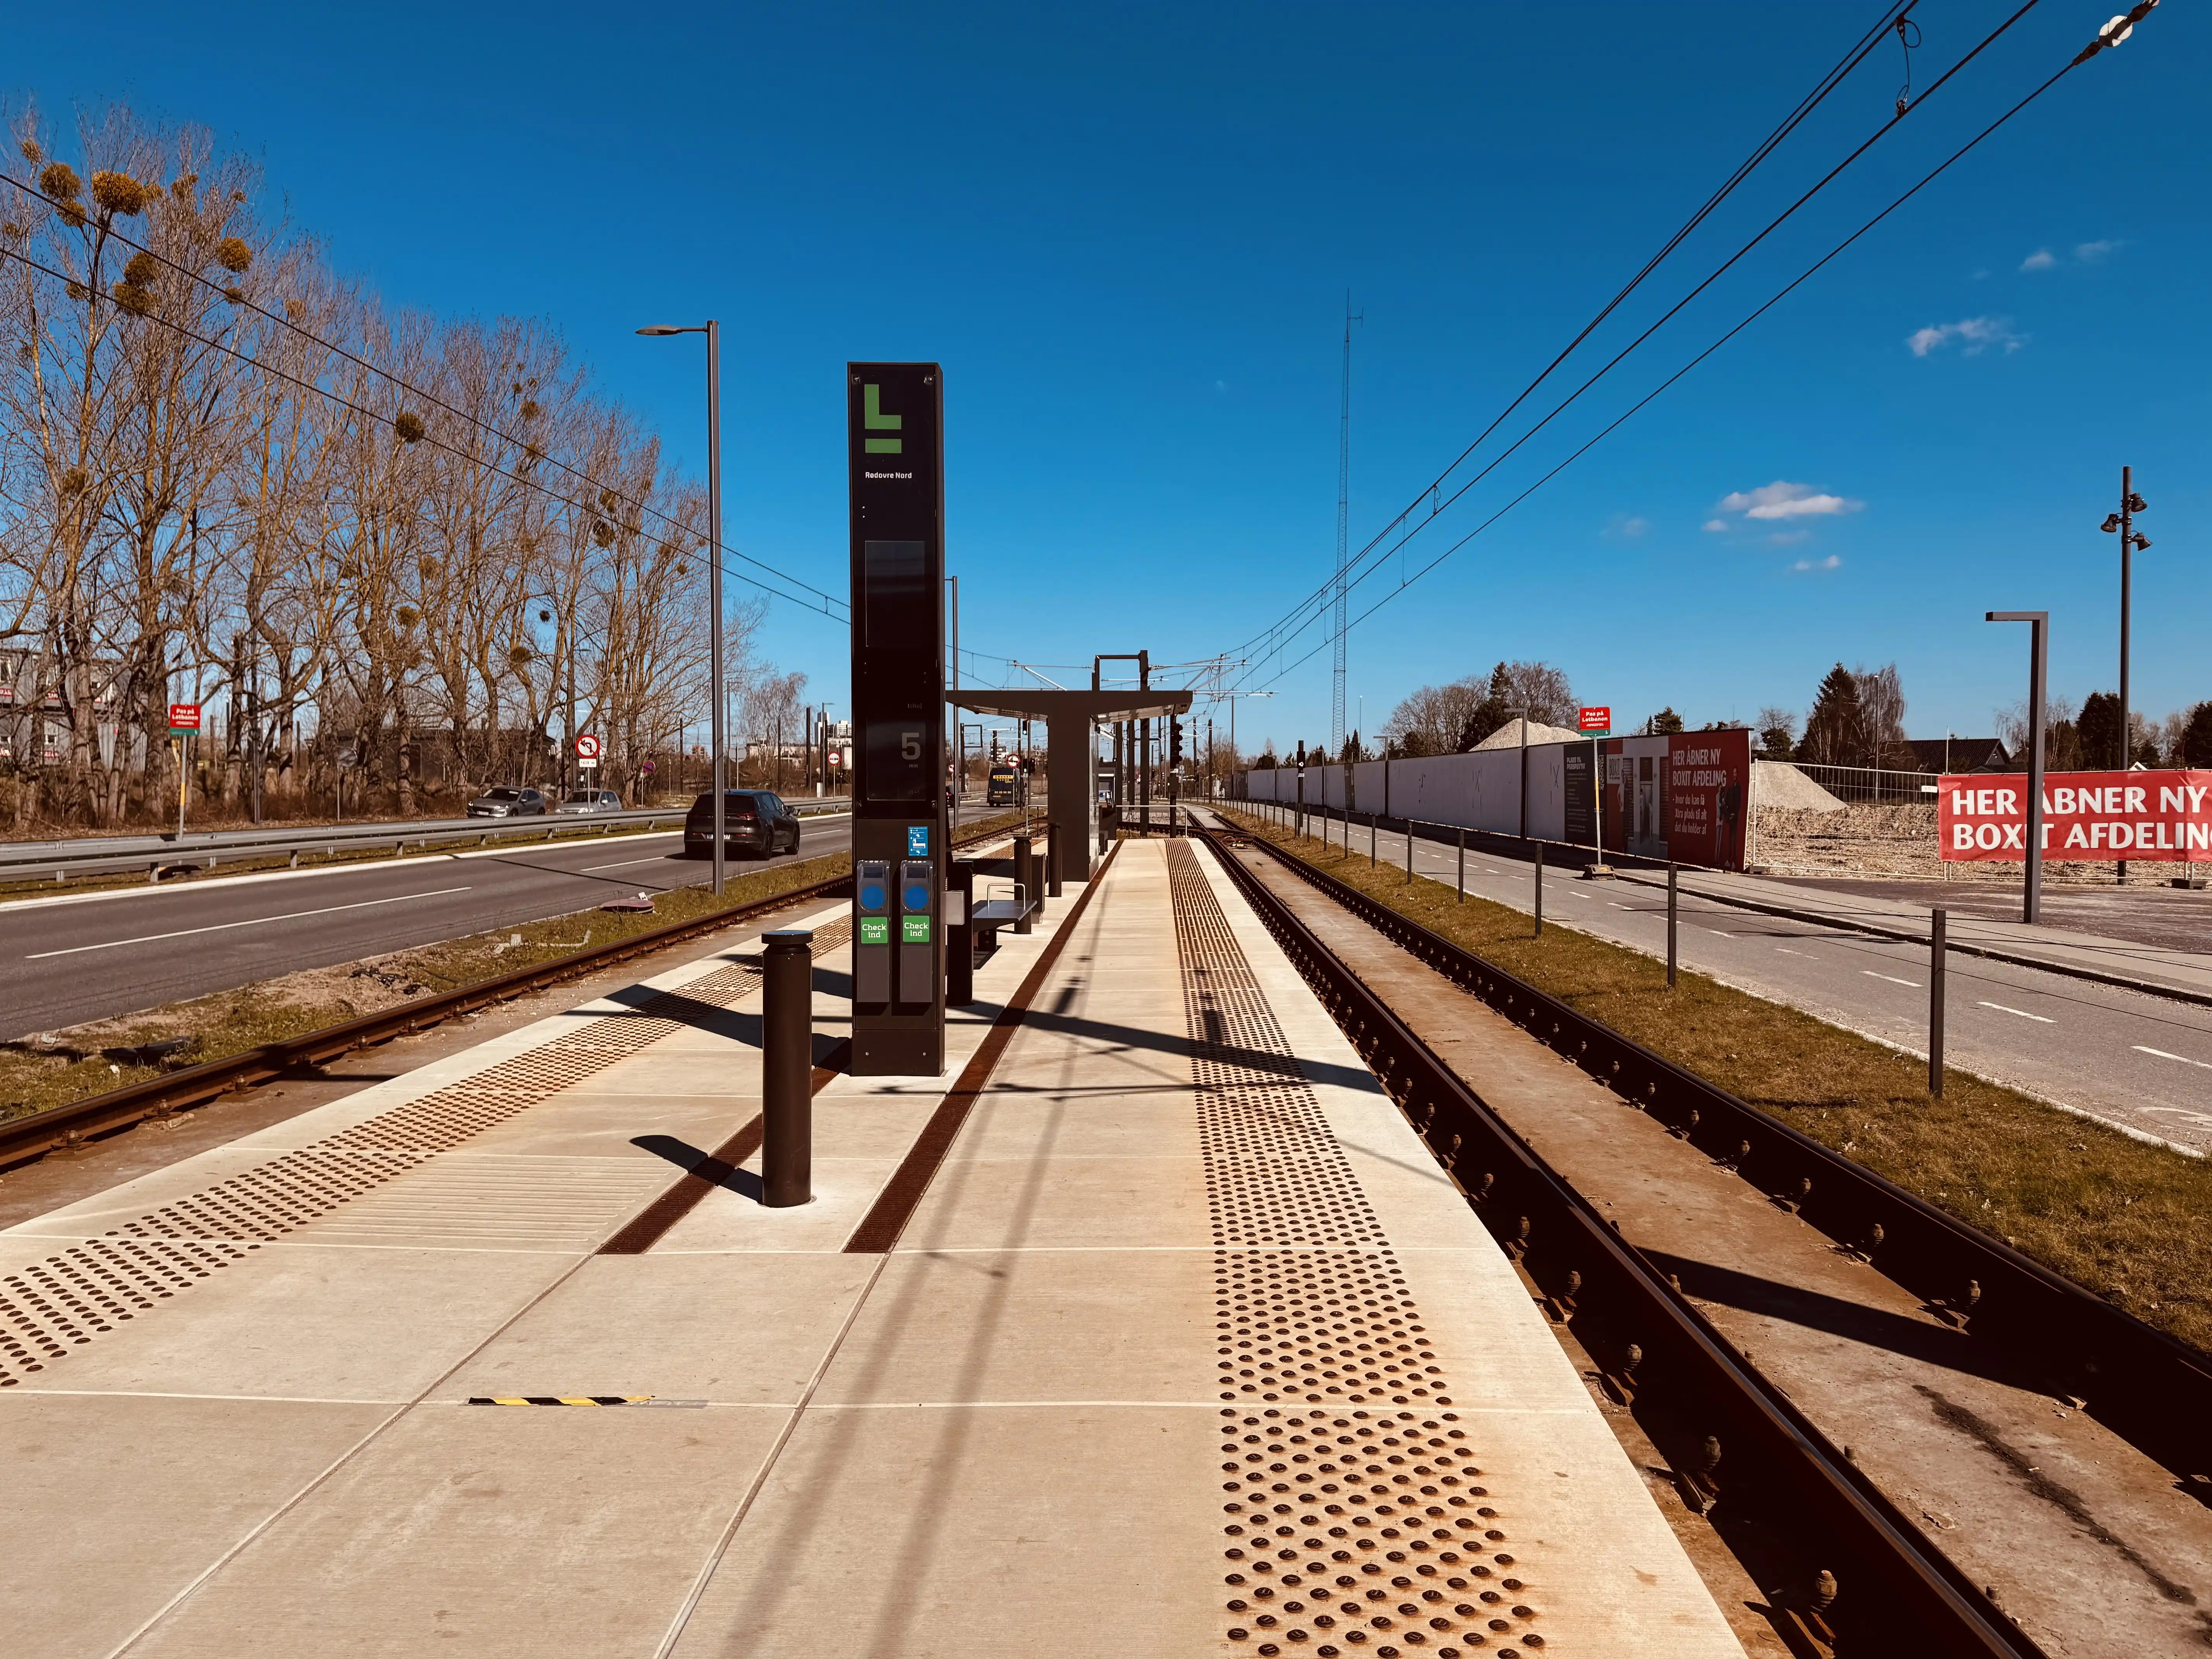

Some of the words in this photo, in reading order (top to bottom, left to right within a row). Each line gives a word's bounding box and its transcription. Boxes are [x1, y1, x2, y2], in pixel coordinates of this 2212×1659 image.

[902, 732, 921, 760] 5
[1673, 750, 1685, 766] HER
[1686, 745, 1709, 765] ÅBNER
[1711, 749, 1721, 765] NY
[1609, 759, 1620, 776] BOXIT
[1673, 771, 1691, 786] BOXIT
[1692, 770, 1727, 787] AFDELING
[1675, 793, 1684, 804] hvor
[1685, 793, 1690, 805] du
[1692, 793, 1700, 805] kan
[1700, 794, 1705, 805] få
[1953, 789, 2018, 815] HER
[2160, 786, 2208, 813] NY
[1684, 807, 1695, 821] plads
[1682, 822, 1687, 833] du
[1688, 823, 1701, 834] holder
[1702, 824, 1707, 835] af
[2064, 823, 2212, 849] AFDELIN
